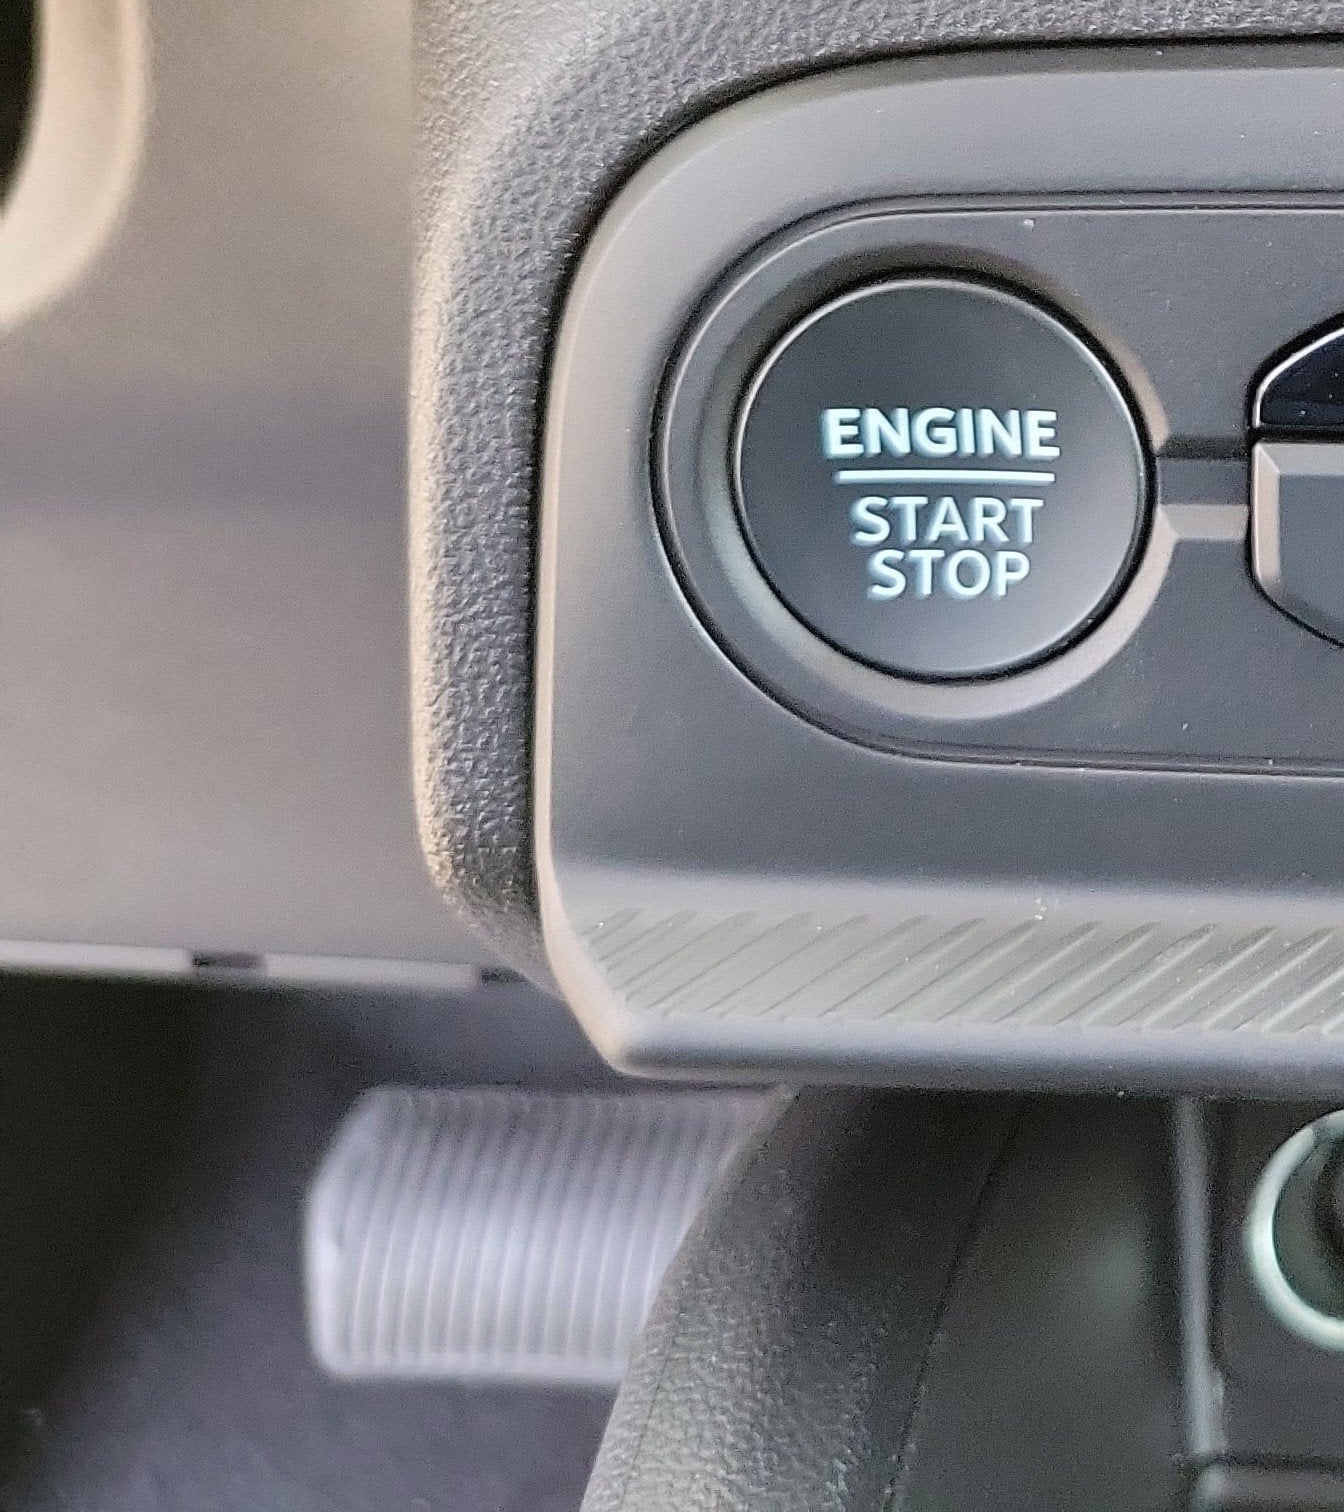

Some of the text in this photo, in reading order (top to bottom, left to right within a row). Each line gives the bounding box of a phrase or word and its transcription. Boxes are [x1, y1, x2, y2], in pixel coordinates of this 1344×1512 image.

[822, 407, 1061, 460] ENGINE
[852, 495, 1044, 546] START
[867, 548, 1031, 601] STOP
